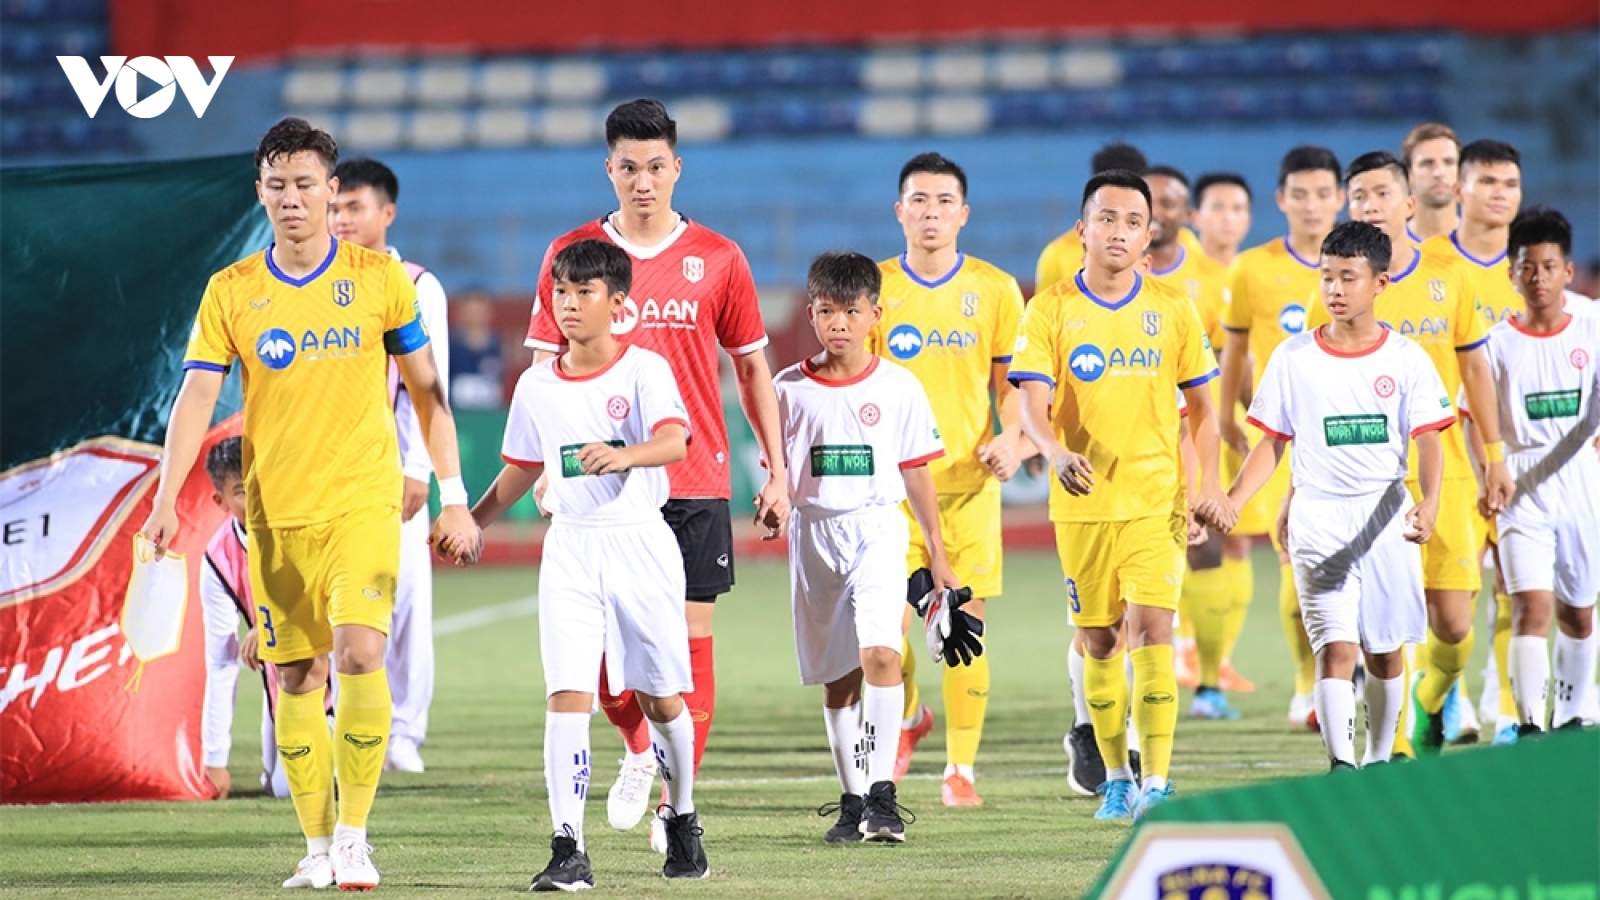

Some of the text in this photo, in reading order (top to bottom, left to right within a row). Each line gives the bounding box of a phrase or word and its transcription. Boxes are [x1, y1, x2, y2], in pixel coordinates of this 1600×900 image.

[641, 298, 699, 322] AAN
[1400, 318, 1448, 335] AAN
[301, 326, 360, 352] AAN
[926, 329, 977, 348] AAN
[1109, 347, 1162, 367] AAN
[842, 455, 871, 472] WOLF
[0, 622, 133, 713] HE
